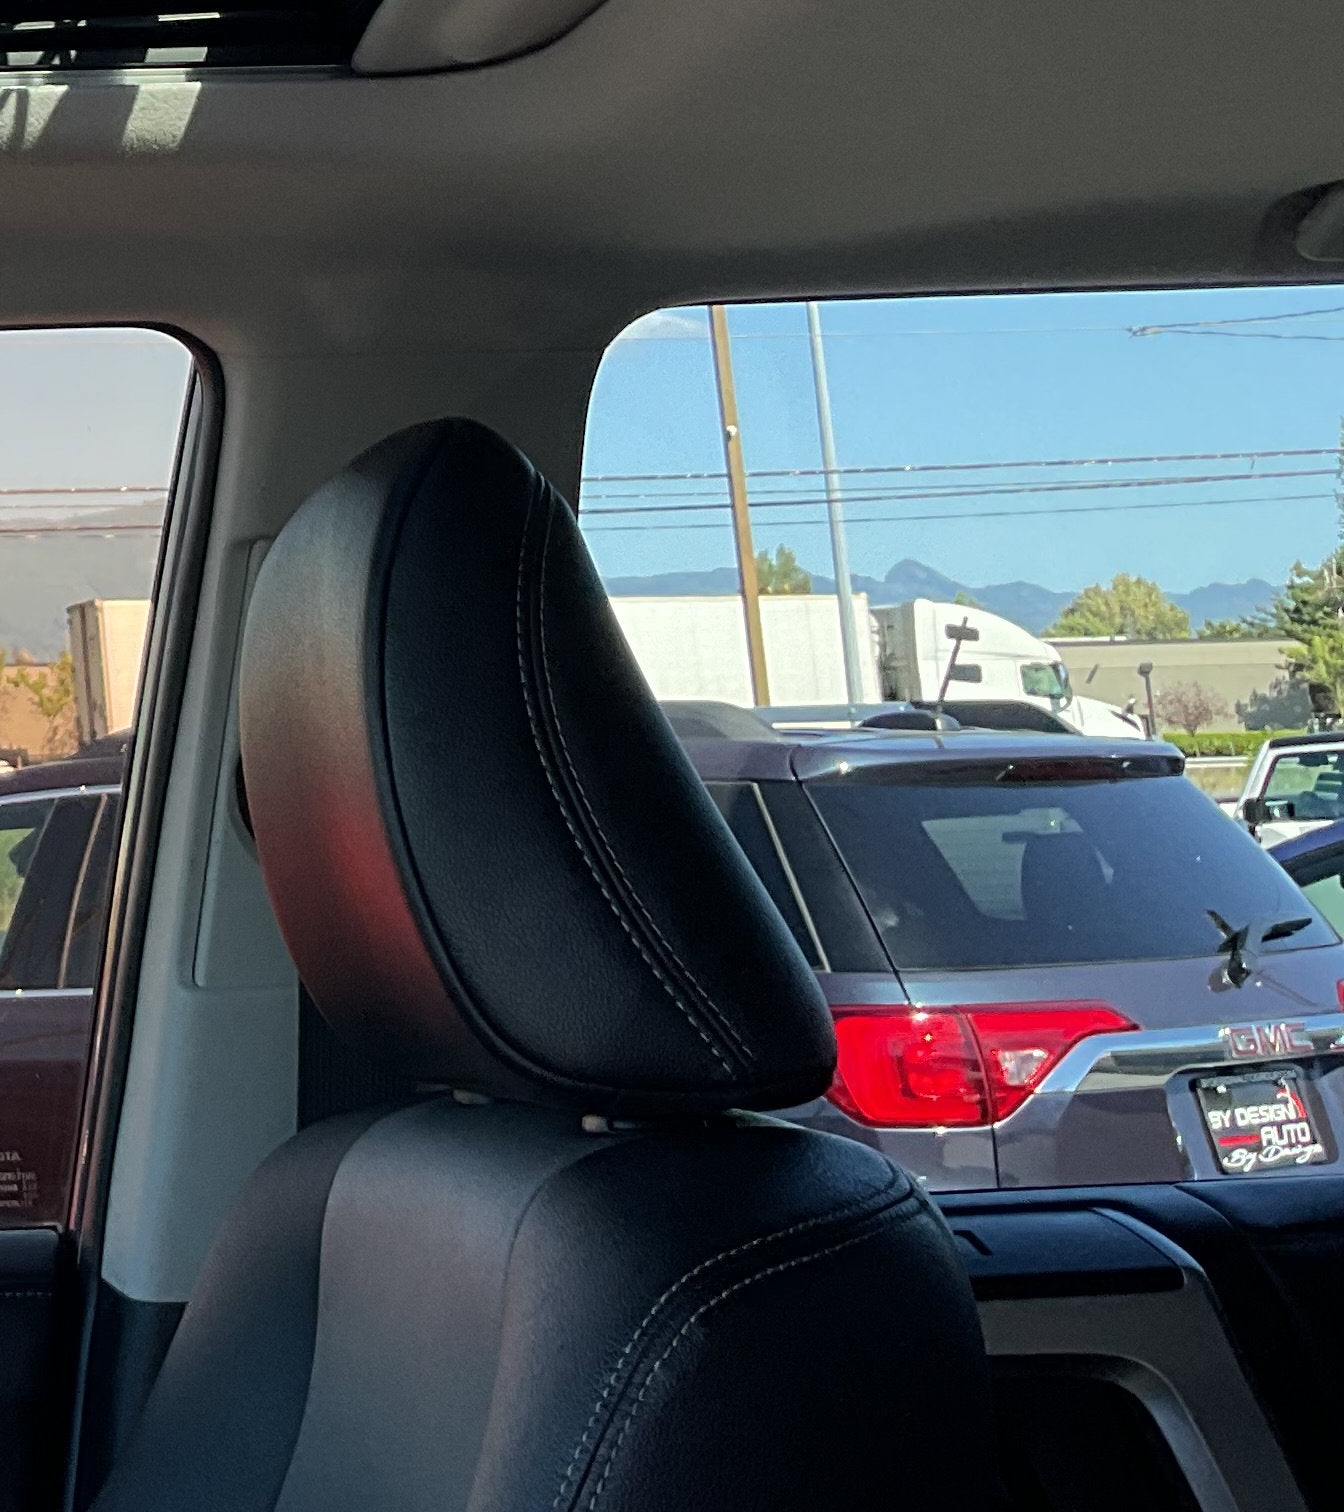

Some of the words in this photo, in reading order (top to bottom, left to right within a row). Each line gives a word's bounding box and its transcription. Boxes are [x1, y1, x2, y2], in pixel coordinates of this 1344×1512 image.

[1230, 1023, 1315, 1058] GMC
[1208, 1109, 1231, 1129] BY
[1234, 1103, 1297, 1127] DESIGN
[1261, 1121, 1311, 1147] AUTO
[1222, 1148, 1258, 1173] By
